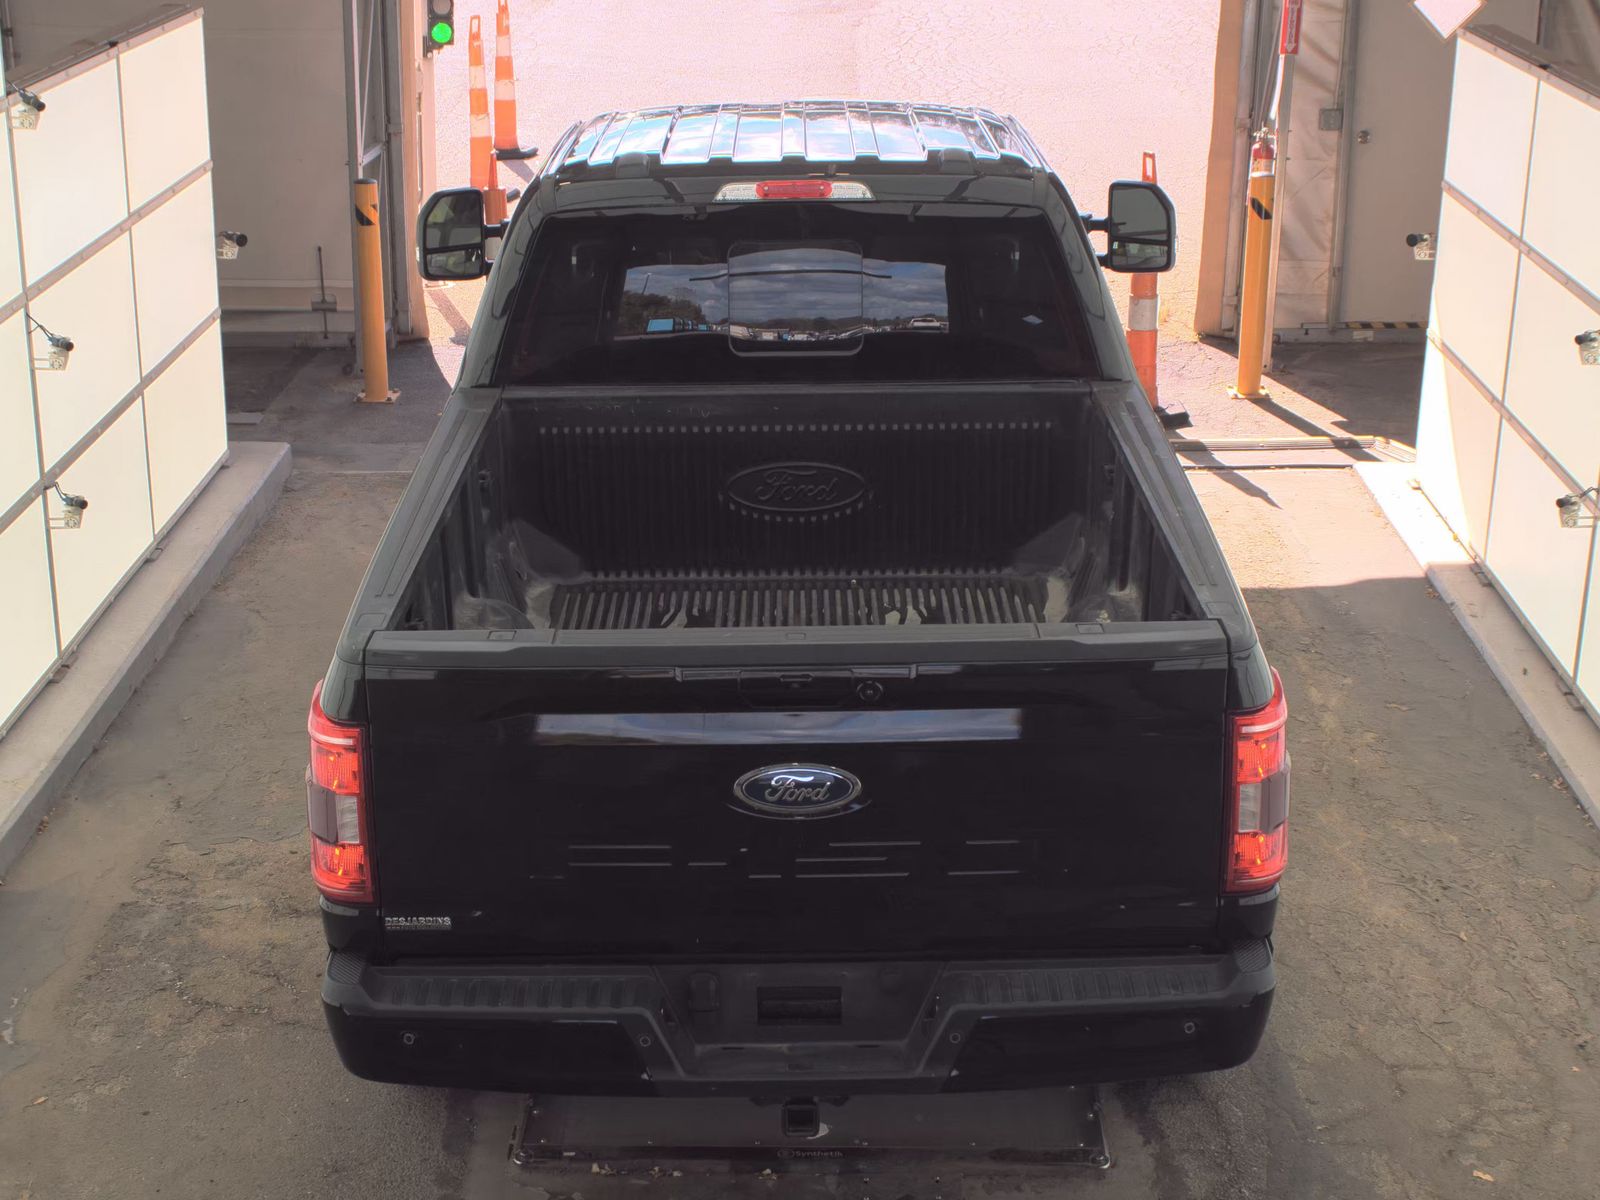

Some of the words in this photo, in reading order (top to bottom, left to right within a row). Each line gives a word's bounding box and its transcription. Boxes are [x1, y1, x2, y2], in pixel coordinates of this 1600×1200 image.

[755, 468, 838, 501] Ford
[764, 775, 831, 801] Ford
[384, 916, 452, 926] DESJARDINS
